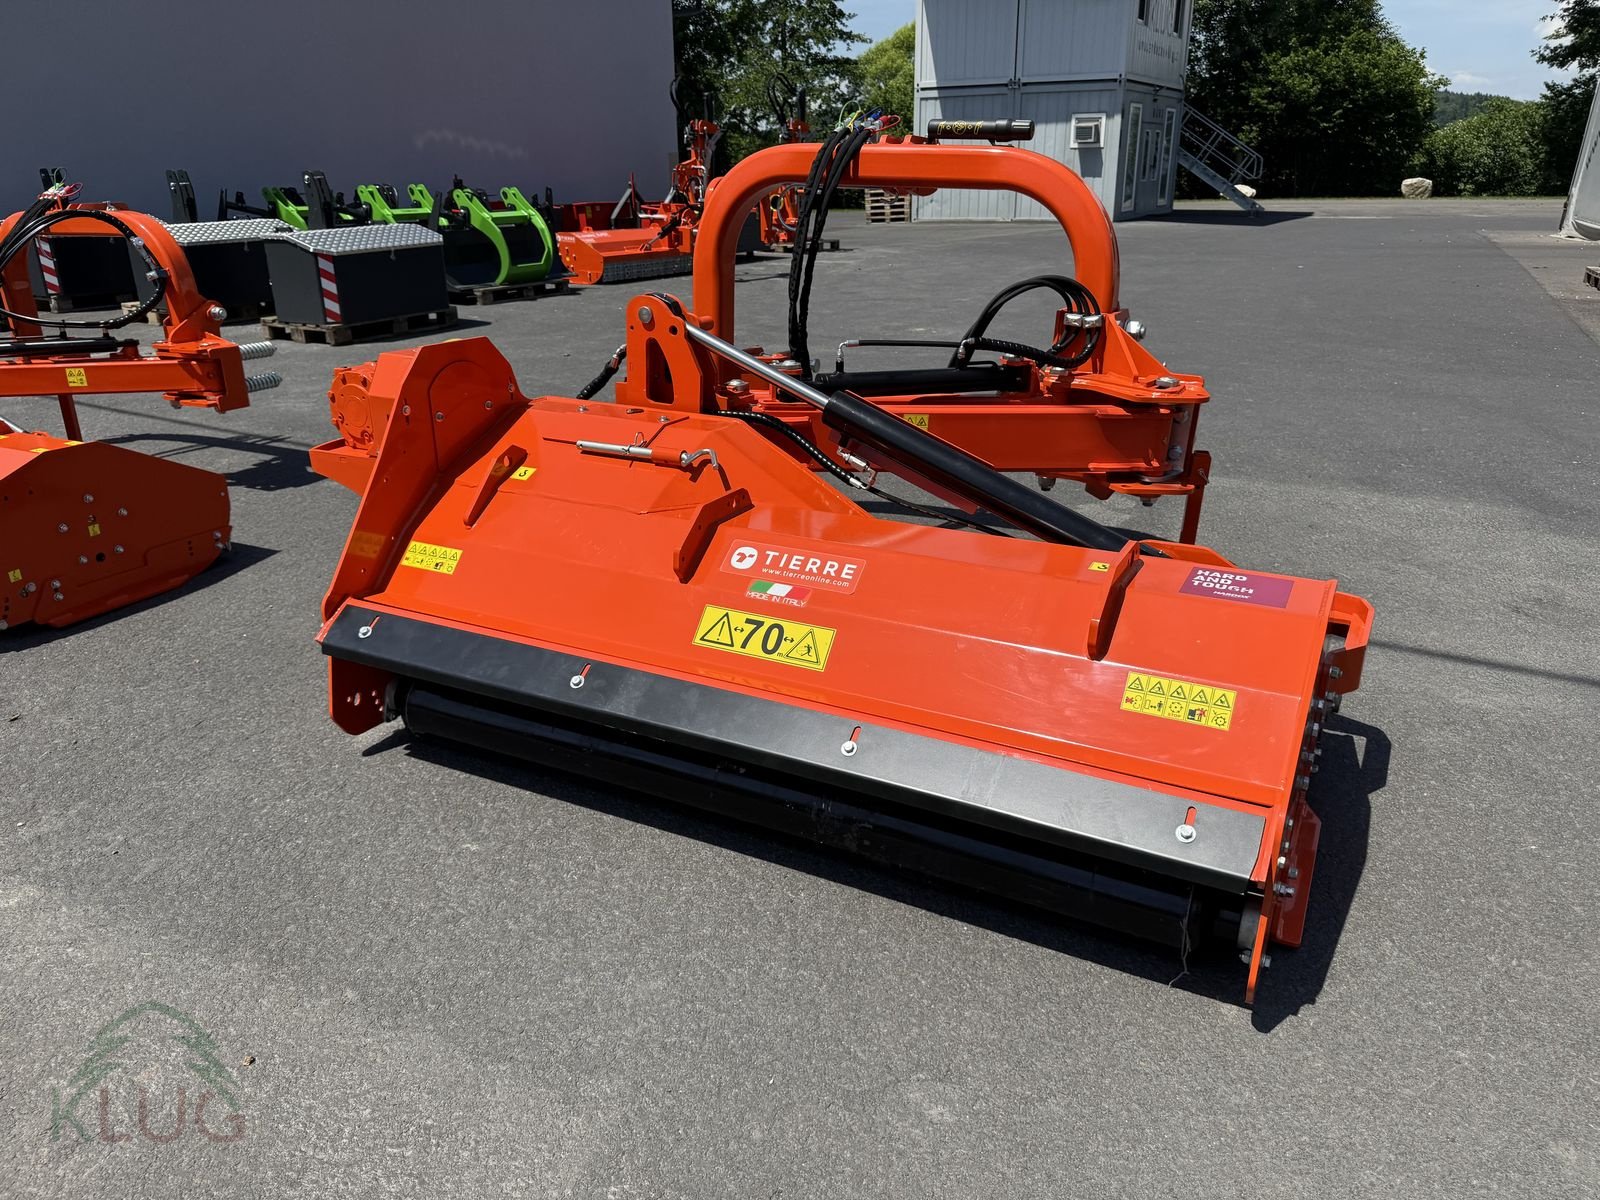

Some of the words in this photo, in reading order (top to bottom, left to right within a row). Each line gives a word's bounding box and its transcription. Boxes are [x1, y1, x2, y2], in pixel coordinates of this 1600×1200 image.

[765, 550, 857, 579] TIERRE
[761, 567, 850, 588] www.tierreonline.com
[1193, 575, 1233, 585] AND
[1196, 569, 1248, 582] HARD
[1192, 579, 1253, 594] TOUGH
[745, 591, 769, 601] MADE
[771, 595, 781, 603] IN
[783, 597, 807, 608] ITALY
[740, 618, 785, 655] 70
